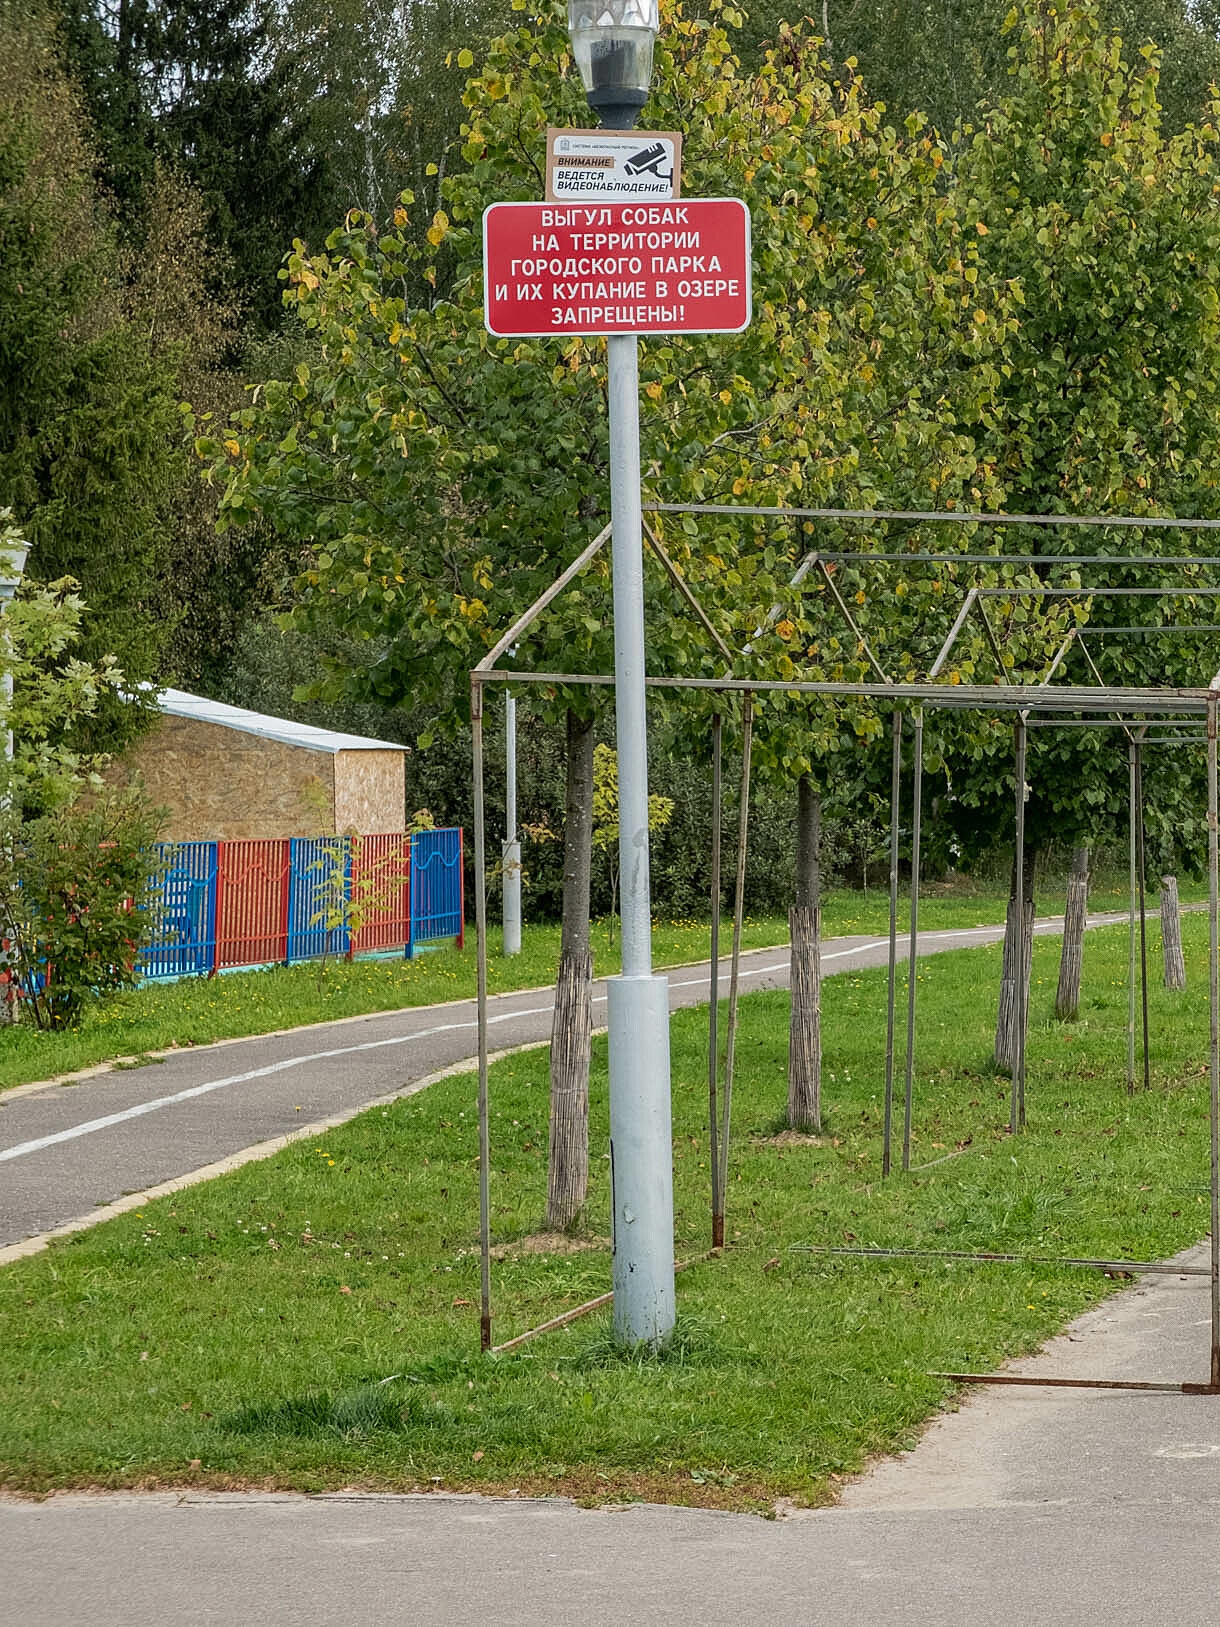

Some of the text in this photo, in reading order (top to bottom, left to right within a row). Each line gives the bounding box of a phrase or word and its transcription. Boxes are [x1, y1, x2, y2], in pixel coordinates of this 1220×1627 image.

[557, 157, 611, 167] ВНИМАНИЕ
[557, 171, 605, 181] ВЕДЕТСЯ
[557, 181, 668, 193] ВИДЕОНАБЛЮДЕНИЕ!
[541, 207, 689, 227] ВЫГУЛ СОБАК
[532, 232, 700, 251] НА ТЕРРИТОРИИ
[511, 255, 722, 278] ГОРОДСКОГО ПАРКА
[495, 279, 739, 301] И ИХ КУПАНИЕ В ОЗЕРЕ
[551, 304, 685, 325] ЗАПРЕЩЕНЫ!
